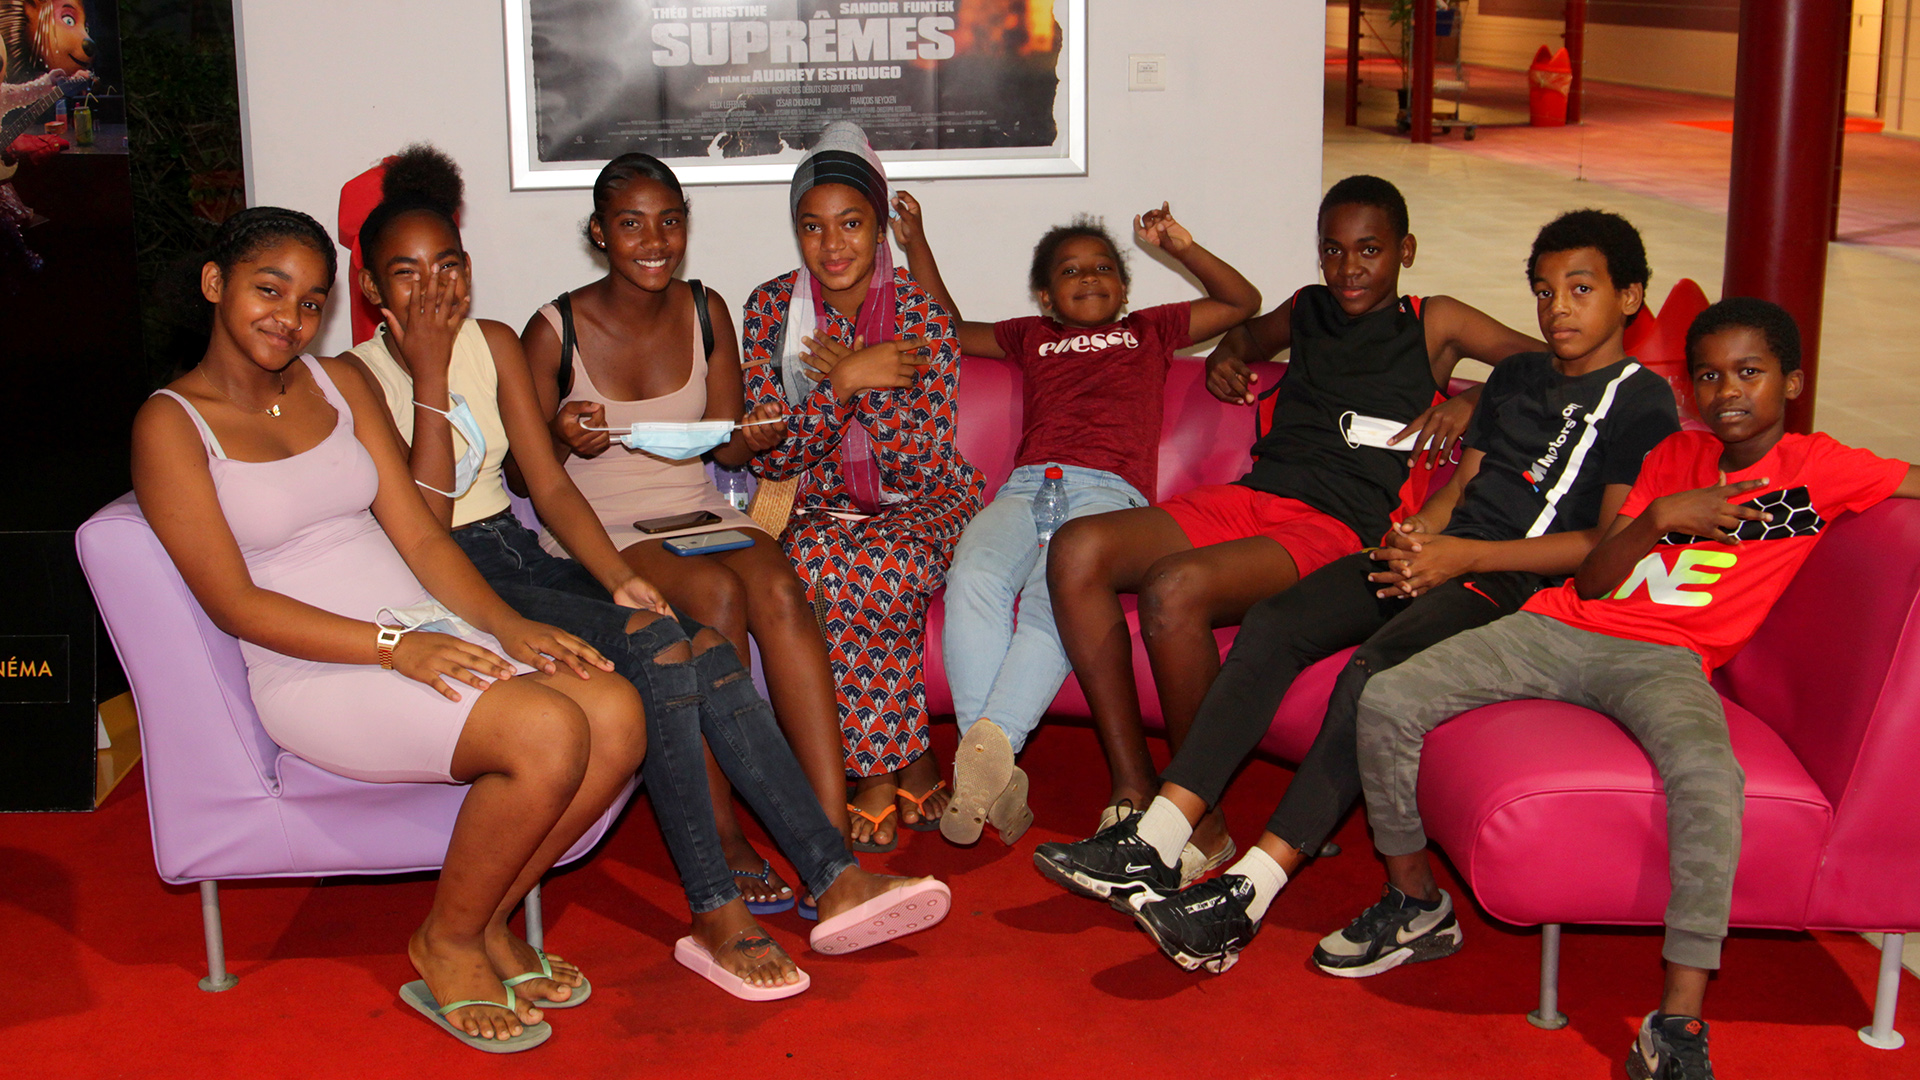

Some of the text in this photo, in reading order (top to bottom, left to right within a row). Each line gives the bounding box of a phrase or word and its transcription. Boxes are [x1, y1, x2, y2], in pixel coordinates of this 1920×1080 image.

[652, 5, 767, 19] THÉO CHRISTINE
[840, 1, 954, 14] SANDOR FUNTEK
[651, 10, 955, 67] SUPRÊMES
[708, 66, 901, 84] UN FILM DE AUDREY ESTROUGO
[771, 85, 791, 94] INSPIRÉ
[792, 86, 801, 94] DES
[802, 84, 821, 94] DÉBUTS
[822, 85, 830, 93] DU
[830, 84, 850, 93] GROUPE
[851, 84, 863, 92] NTM
[775, 97, 793, 107] CÉSAR
[849, 96, 874, 106] FRANÇOIS
[1038, 331, 1139, 357] ellesse
[1537, 402, 1583, 468] Motorsor
[1600, 549, 1738, 607] NE
